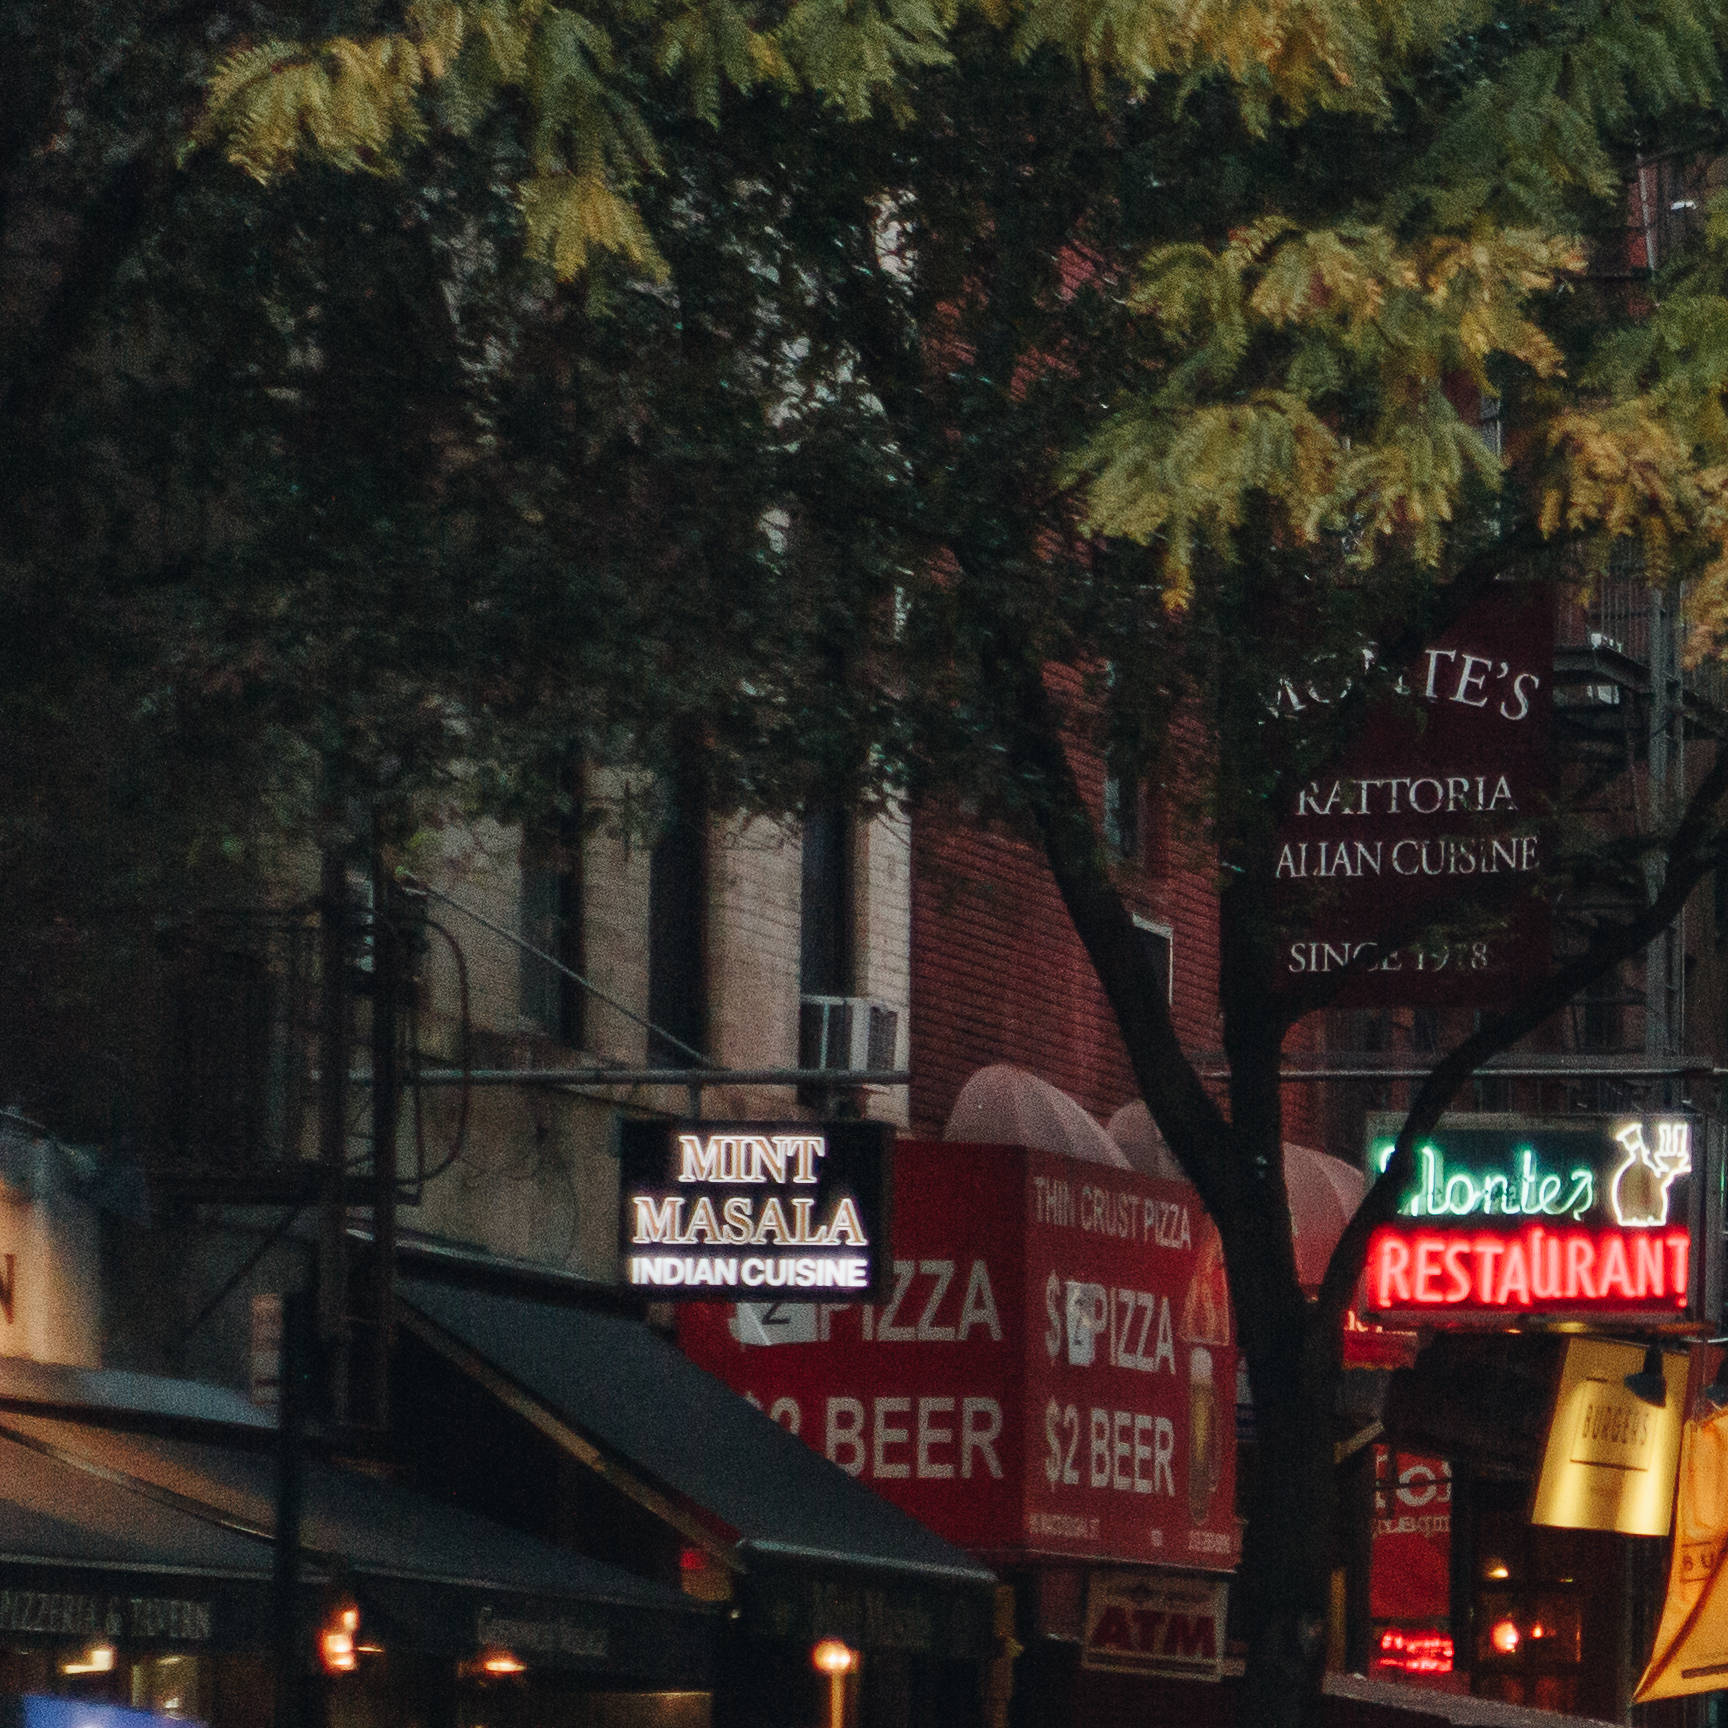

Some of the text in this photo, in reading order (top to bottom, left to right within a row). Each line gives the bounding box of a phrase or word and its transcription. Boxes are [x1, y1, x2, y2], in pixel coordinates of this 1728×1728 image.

[1391, 836, 1541, 876] CUISINE
[678, 1135, 826, 1184] MINT
[632, 1197, 869, 1246] MASALA
[1033, 1176, 1192, 1251] THIN CRUST PIZZA
[631, 1257, 869, 1288] INDIAN CUISINE
[1379, 1229, 1691, 1308] RESTAURANT
[1093, 1283, 1177, 1376] PIZZA
[825, 1396, 1005, 1480] BEER
[1045, 1398, 1176, 1498] $2 BEER
[1092, 1605, 1217, 1658] ATM
